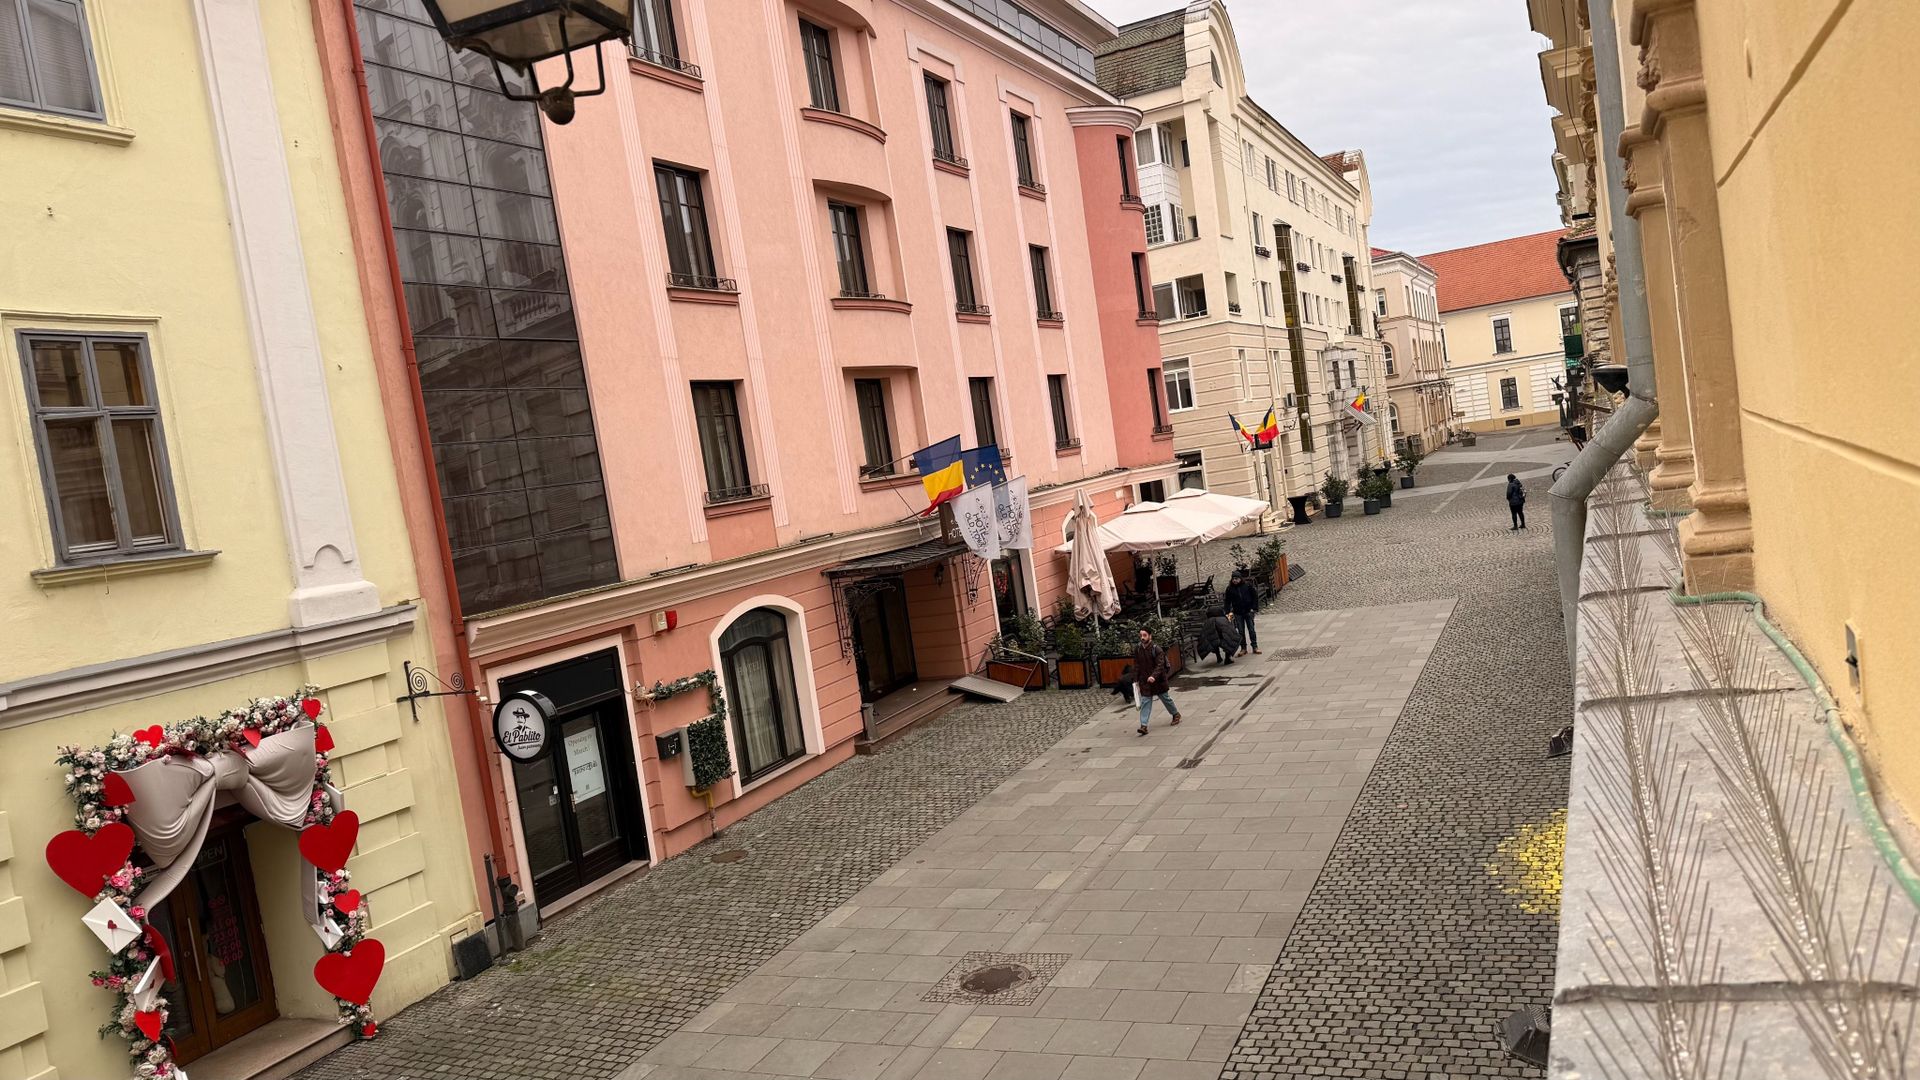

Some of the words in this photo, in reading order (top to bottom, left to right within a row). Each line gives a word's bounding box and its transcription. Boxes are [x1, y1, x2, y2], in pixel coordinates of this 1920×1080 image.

[998, 503, 1007, 519] OLD
[965, 512, 975, 527] OLD
[503, 730, 512, 744] El
[512, 729, 541, 743] Pablito
